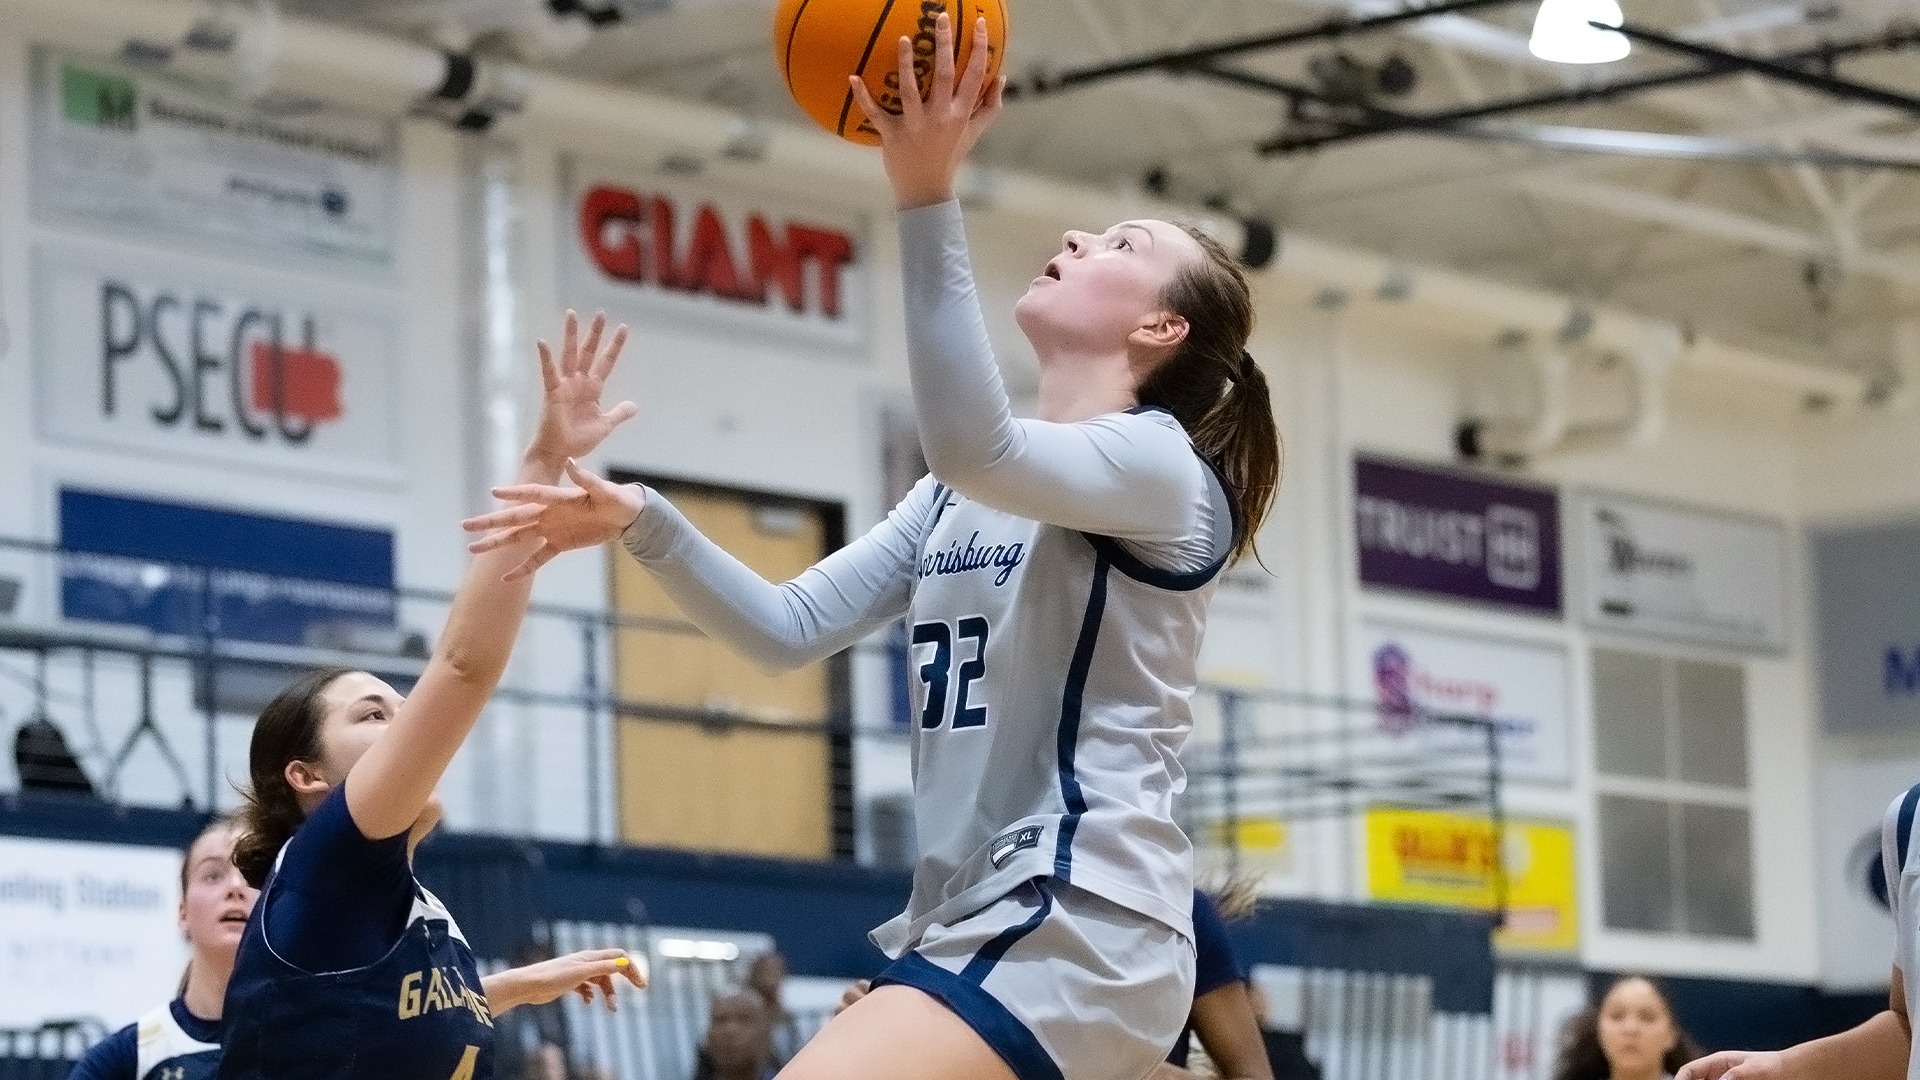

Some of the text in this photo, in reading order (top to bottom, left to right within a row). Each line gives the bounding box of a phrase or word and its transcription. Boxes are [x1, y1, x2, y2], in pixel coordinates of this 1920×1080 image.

[579, 184, 857, 321] GIANT
[102, 280, 317, 445] PSECU
[911, 616, 988, 730] 32
[1018, 831, 1034, 843] XL
